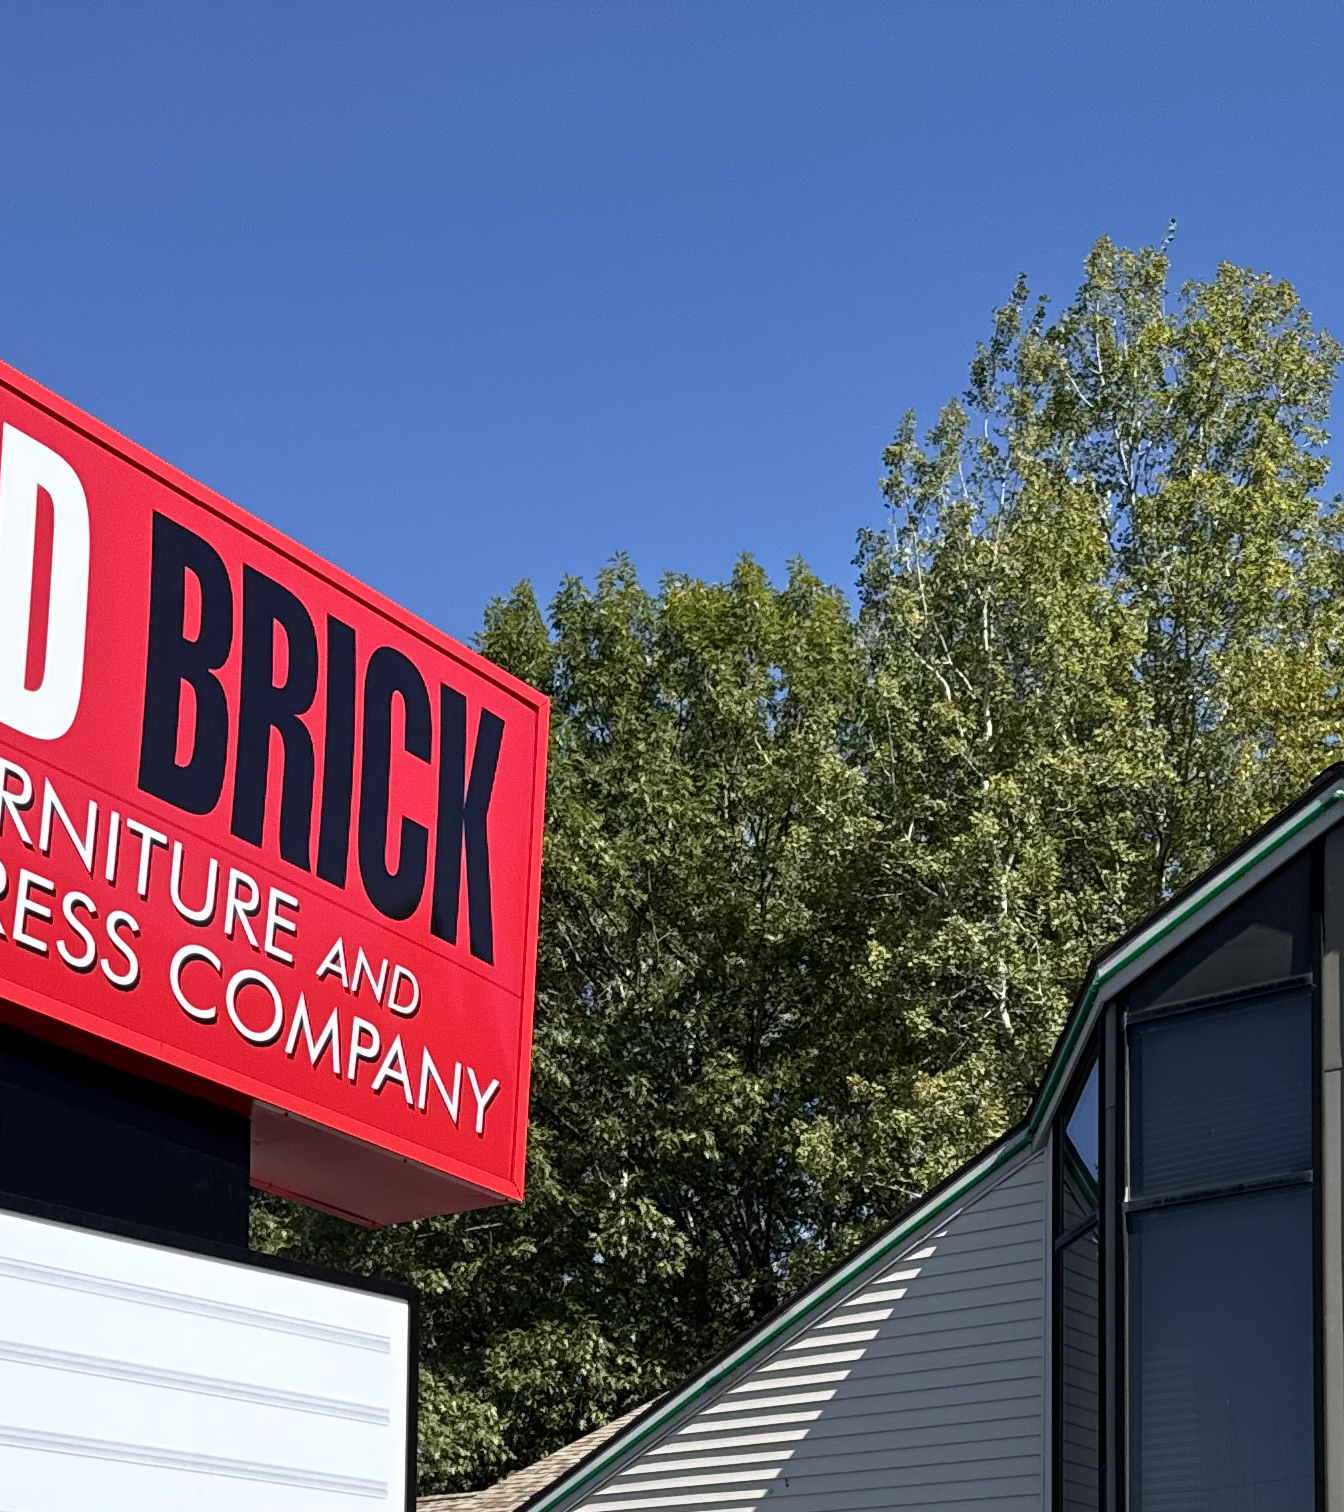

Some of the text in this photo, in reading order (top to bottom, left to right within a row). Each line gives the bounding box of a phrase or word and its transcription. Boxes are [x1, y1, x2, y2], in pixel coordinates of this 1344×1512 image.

[138, 512, 504, 965] BRICK
[170, 945, 500, 1135] COMPANY
[315, 937, 420, 1018] AND
